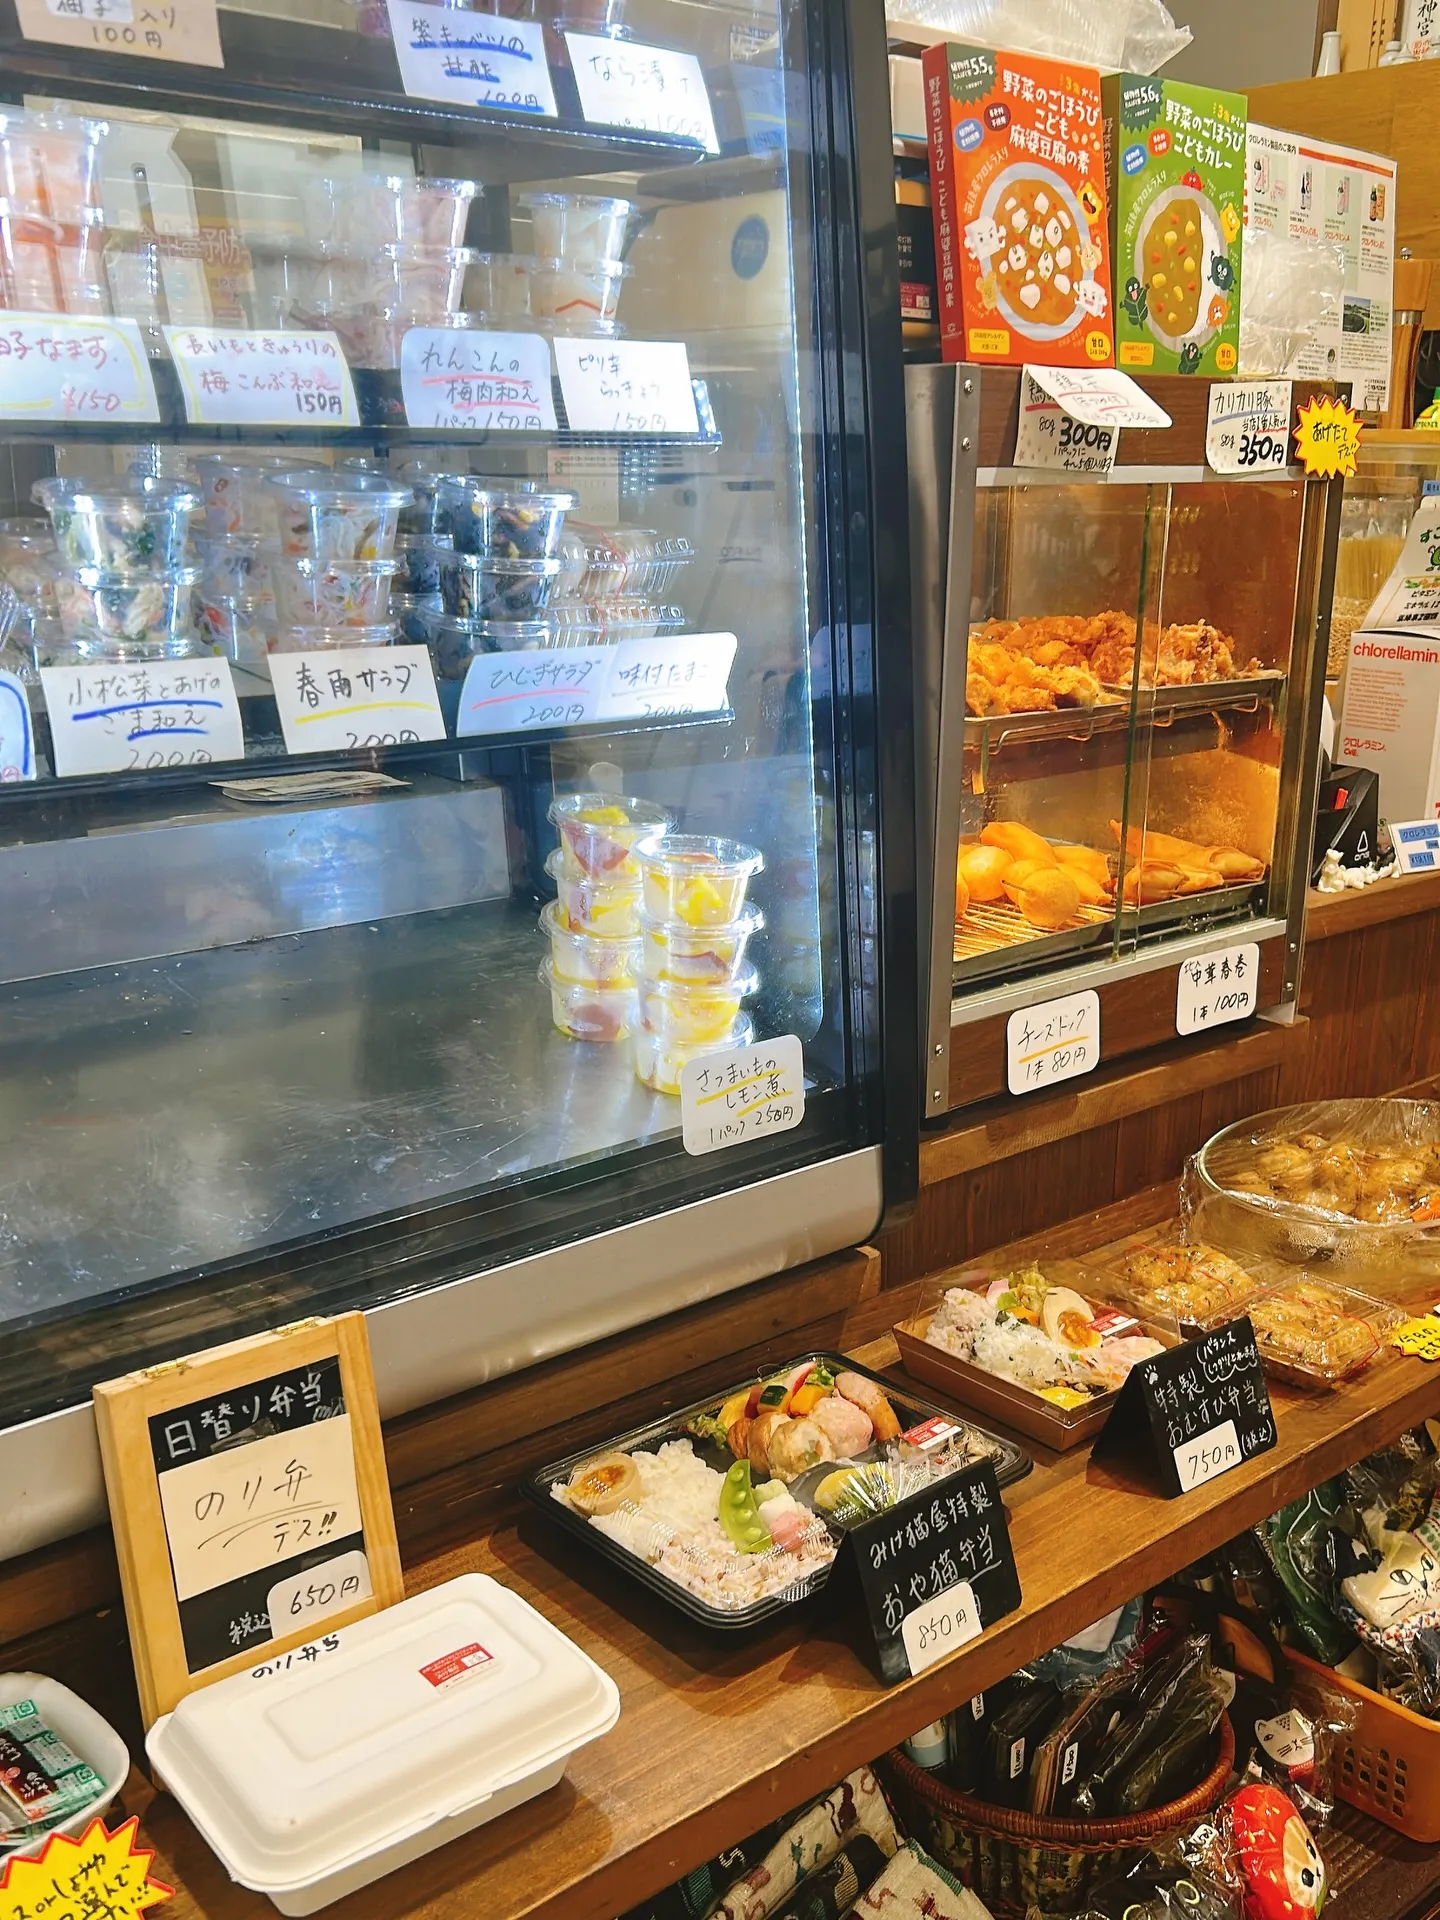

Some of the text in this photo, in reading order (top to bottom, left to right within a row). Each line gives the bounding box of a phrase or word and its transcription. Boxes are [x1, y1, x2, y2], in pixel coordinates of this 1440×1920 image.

[92, 26, 162, 49] 100円
[483, 90, 538, 107] 100円
[1003, 69, 1101, 127] 野菜のごほうび
[928, 76, 946, 173] 野菜のごほうび
[1034, 108, 1069, 141] こども
[1165, 98, 1245, 153] 野菜のごほうび
[1009, 124, 1090, 175] 麻婆豆腐の素
[1173, 131, 1233, 169] こどもカレー
[421, 342, 520, 372] れんこんの
[296, 393, 343, 415] 150円
[445, 379, 540, 405] 梅肉和え
[1215, 390, 1273, 414] カリカリ豚
[1059, 416, 1112, 452] 300円
[1237, 434, 1284, 466] 350円
[1312, 421, 1348, 443] あげたて
[1353, 642, 1439, 664] chlorellamin
[68, 670, 221, 707] 小松菜とあげの
[296, 662, 418, 708] 春雨サラダ
[104, 704, 206, 735] ごま和え
[521, 706, 585, 724] 200円
[1343, 737, 1386, 751] クロレラミン
[1190, 954, 1248, 988] 中華春巻
[1193, 992, 1249, 1022] 1本 100円
[1018, 1006, 1091, 1052] チーズドッグ
[696, 1057, 777, 1093] さつまいもの
[1026, 1046, 1086, 1081] 1本 80円
[726, 1073, 787, 1109] レモン煮
[709, 1104, 794, 1144] 1パック 250円
[1203, 1330, 1237, 1360] バランス
[1154, 1367, 1206, 1414] 特製
[164, 1370, 324, 1459] 日替り弁当
[1165, 1379, 1257, 1449] おむすび弁当
[1188, 1445, 1236, 1481] 750円
[195, 1458, 313, 1522] のり弁
[869, 1481, 993, 1570] みけ猫屋特製
[881, 1523, 994, 1630] おや猫弁当
[228, 1574, 360, 1646] 税込 650円
[918, 1608, 968, 1650] 850円
[252, 1633, 340, 1679] のり弁当
